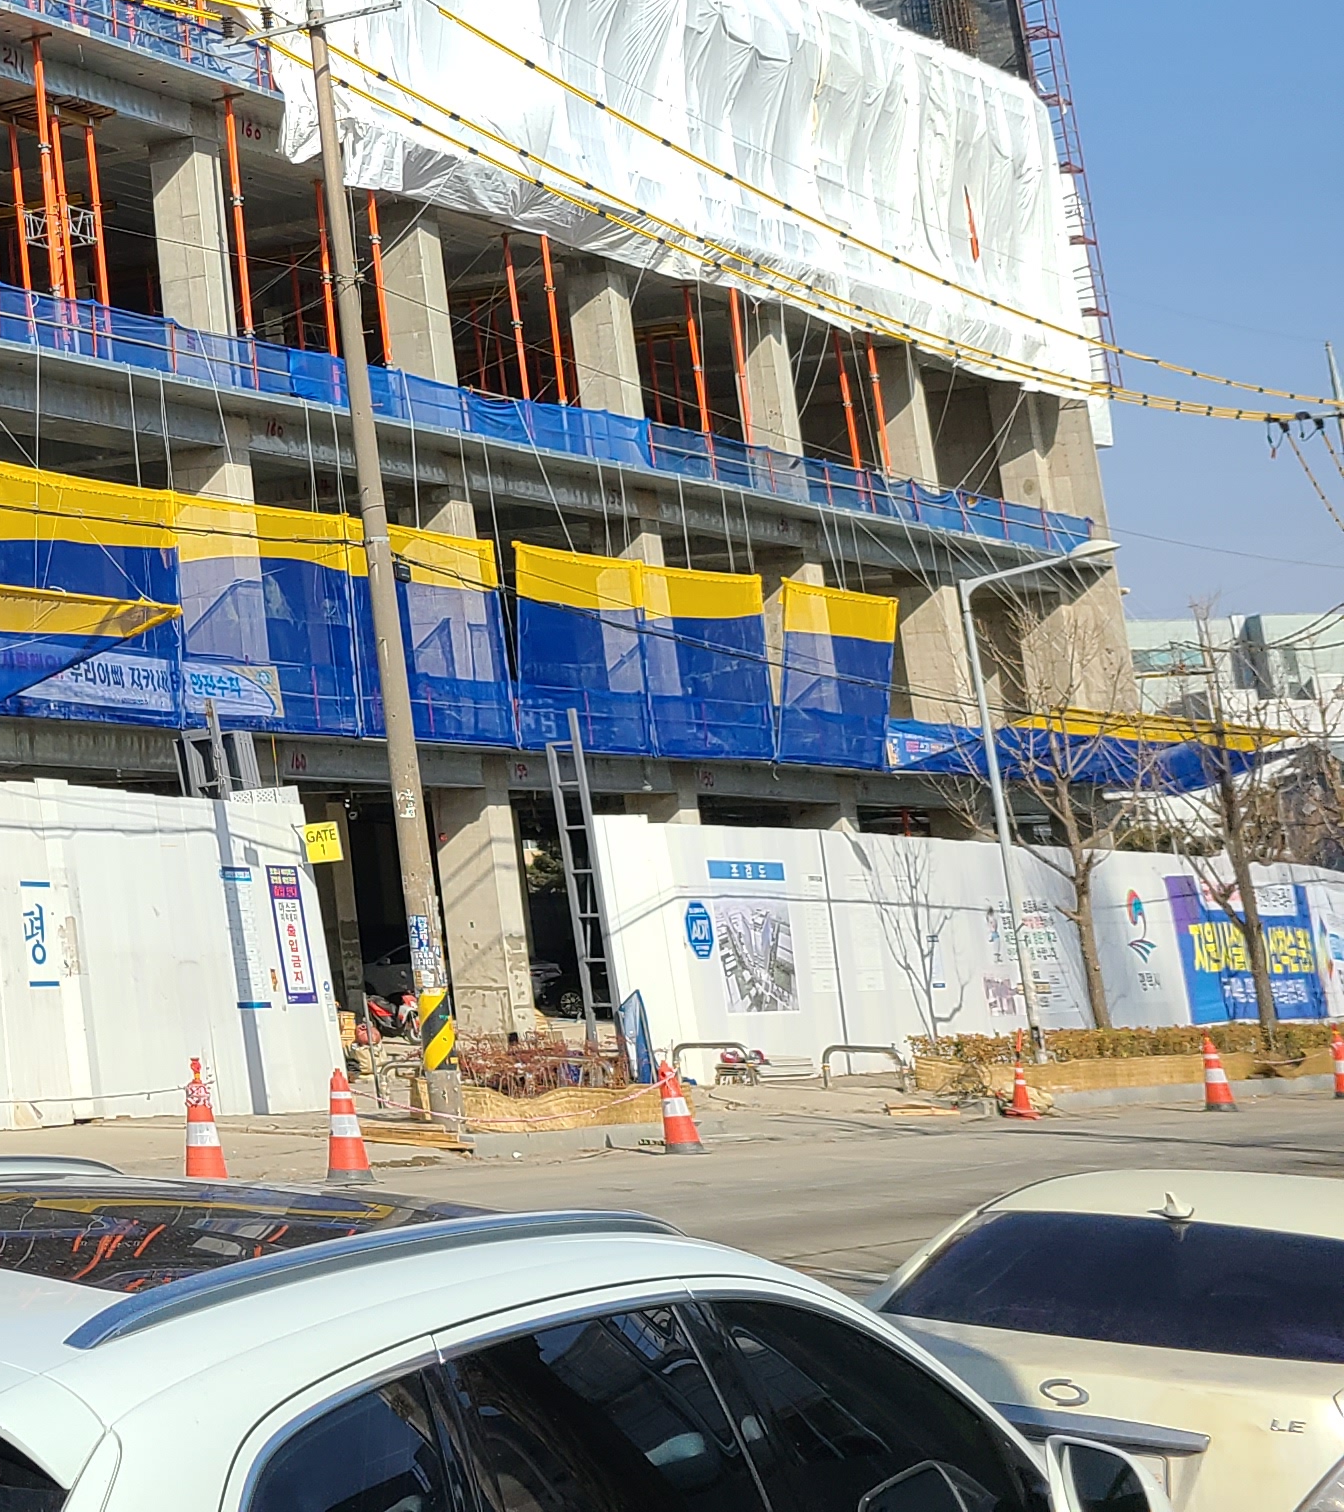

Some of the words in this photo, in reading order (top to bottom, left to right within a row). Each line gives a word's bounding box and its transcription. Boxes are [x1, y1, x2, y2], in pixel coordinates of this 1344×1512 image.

[241, 119, 262, 140] 160
[70, 662, 124, 688] 우리아빠
[189, 672, 242, 699] 안전수칙
[305, 828, 337, 843] GATE
[320, 843, 326, 856] 1
[729, 863, 767, 879] 조감도
[278, 901, 298, 913] 마스크
[22, 902, 47, 965] 평
[691, 919, 710, 941] ADT
[286, 923, 305, 984] 출입금지
[1269, 1417, 1307, 1434] LE
